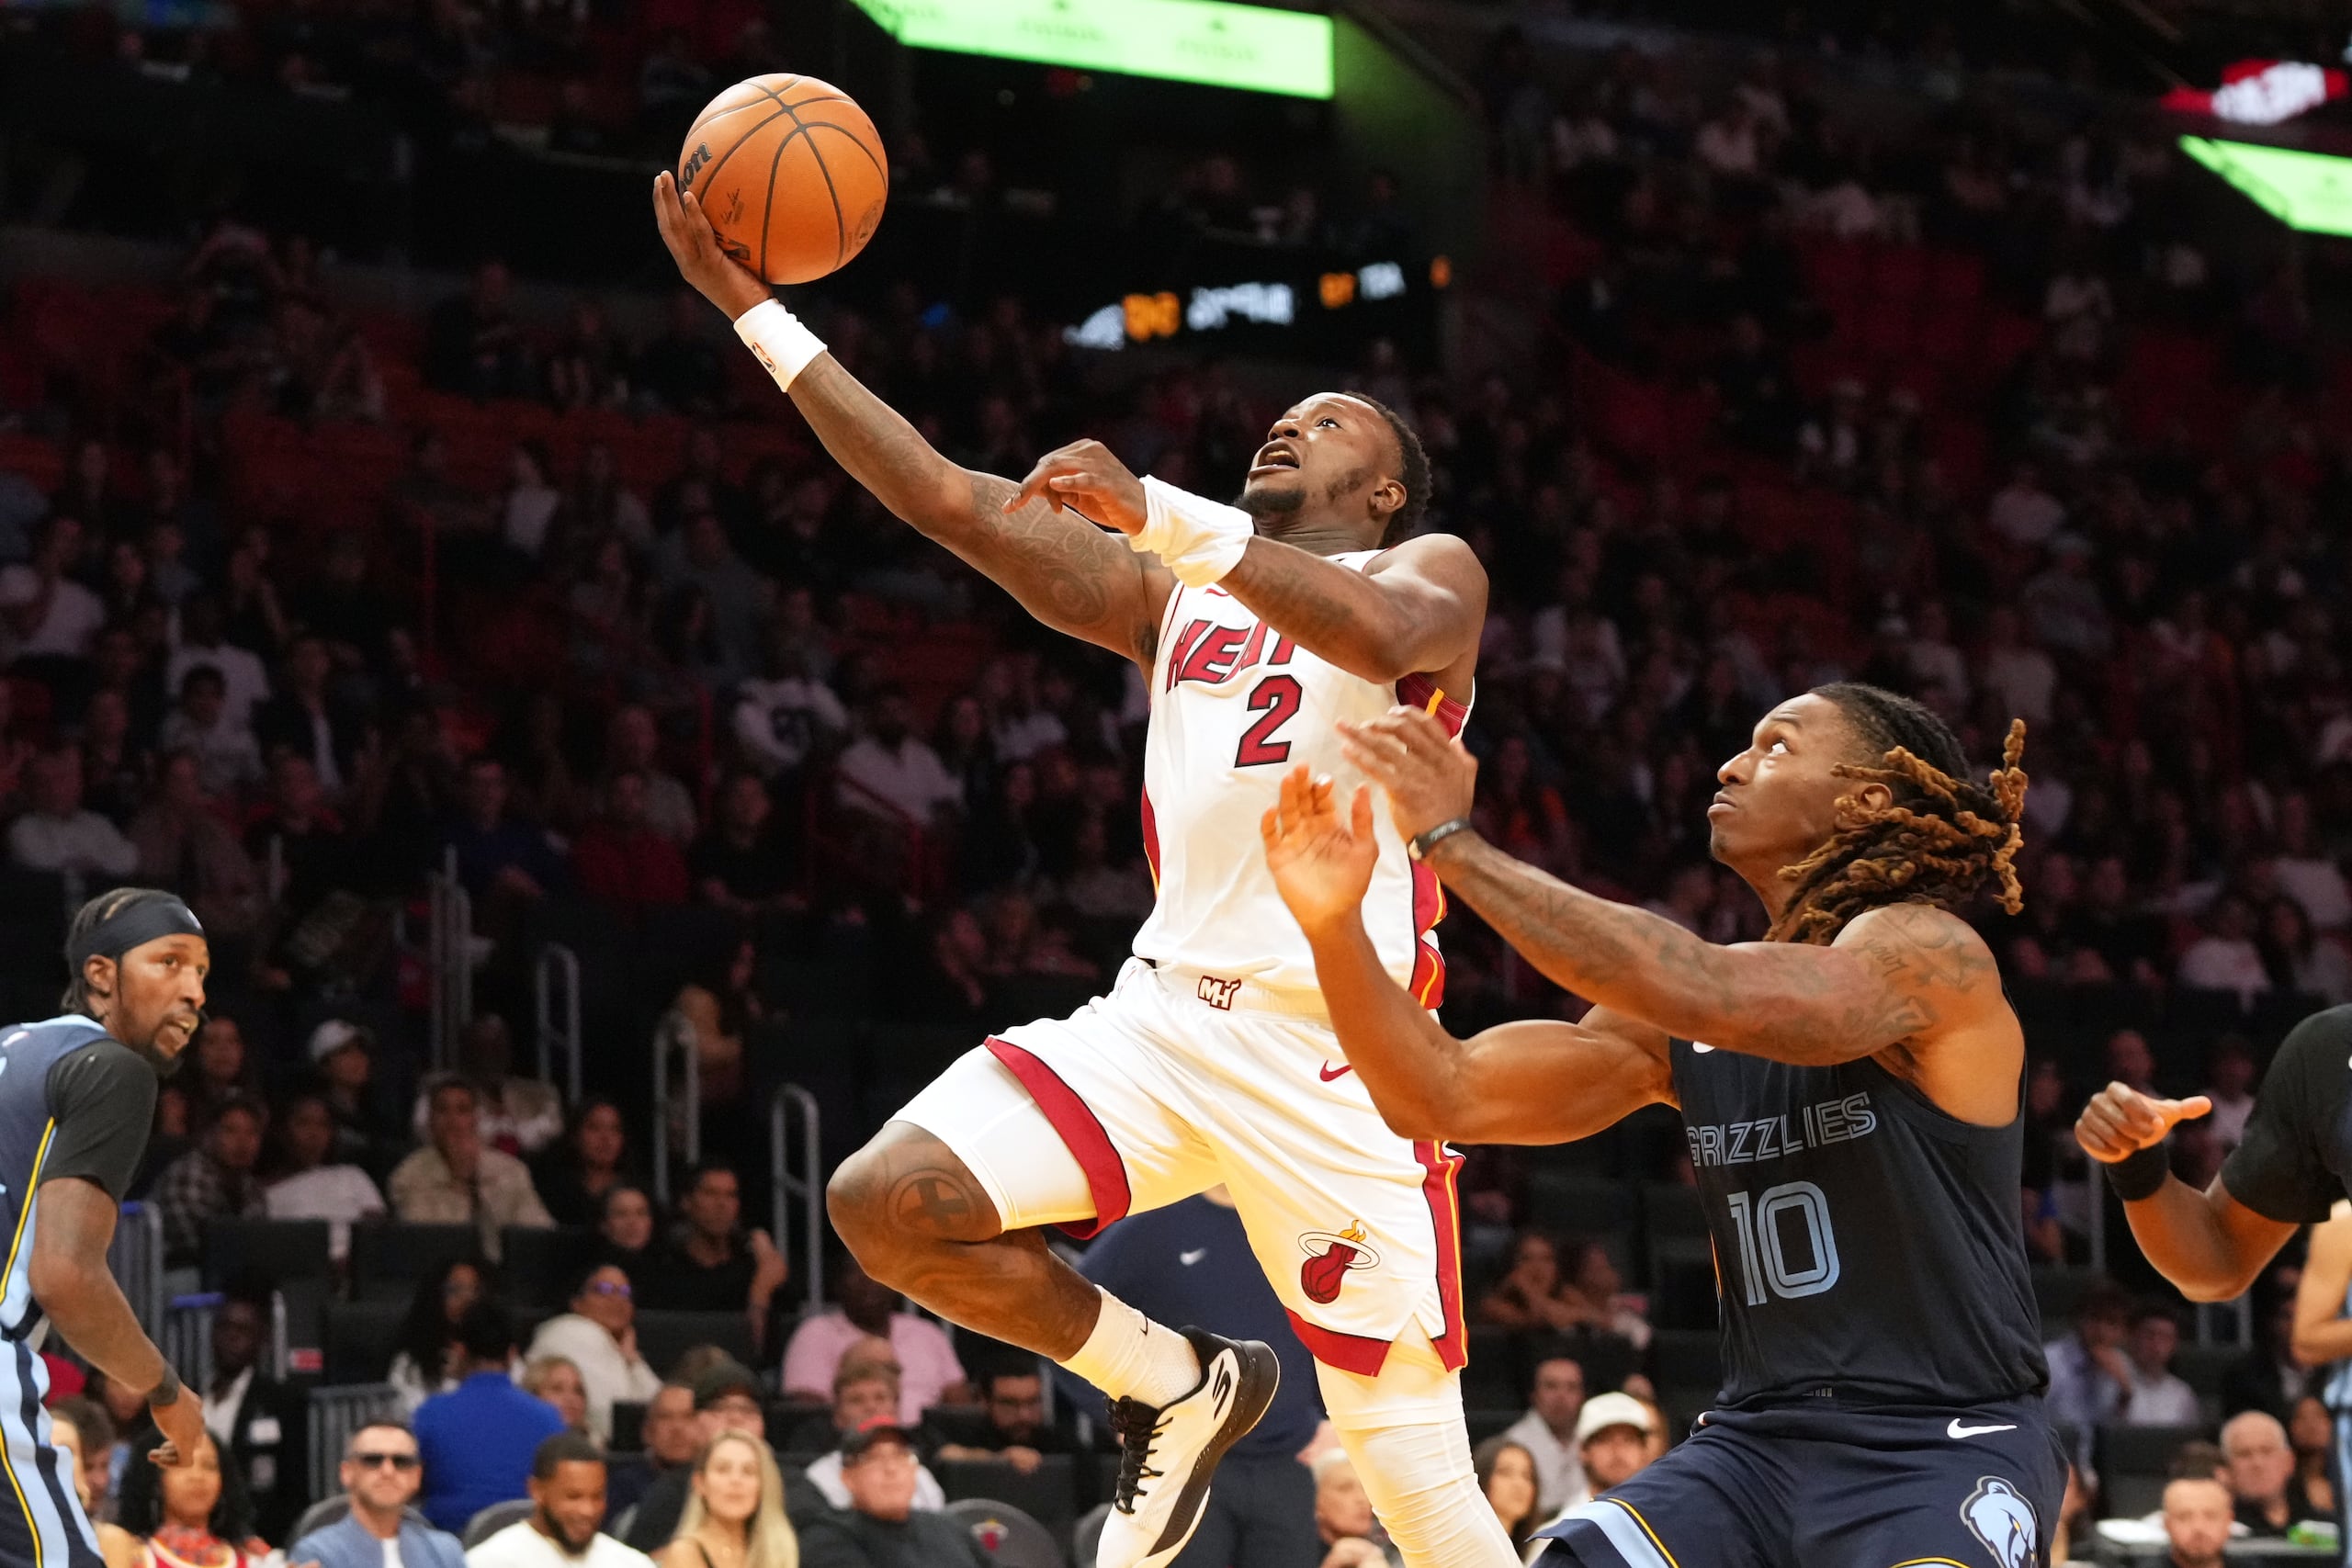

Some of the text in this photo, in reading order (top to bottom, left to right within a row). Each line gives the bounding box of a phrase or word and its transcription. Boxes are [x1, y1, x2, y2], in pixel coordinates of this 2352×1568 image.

[1234, 673, 1304, 768] 2
[1685, 1090, 1877, 1168] GRIZZLIES
[1726, 1180, 1840, 1306] 10
